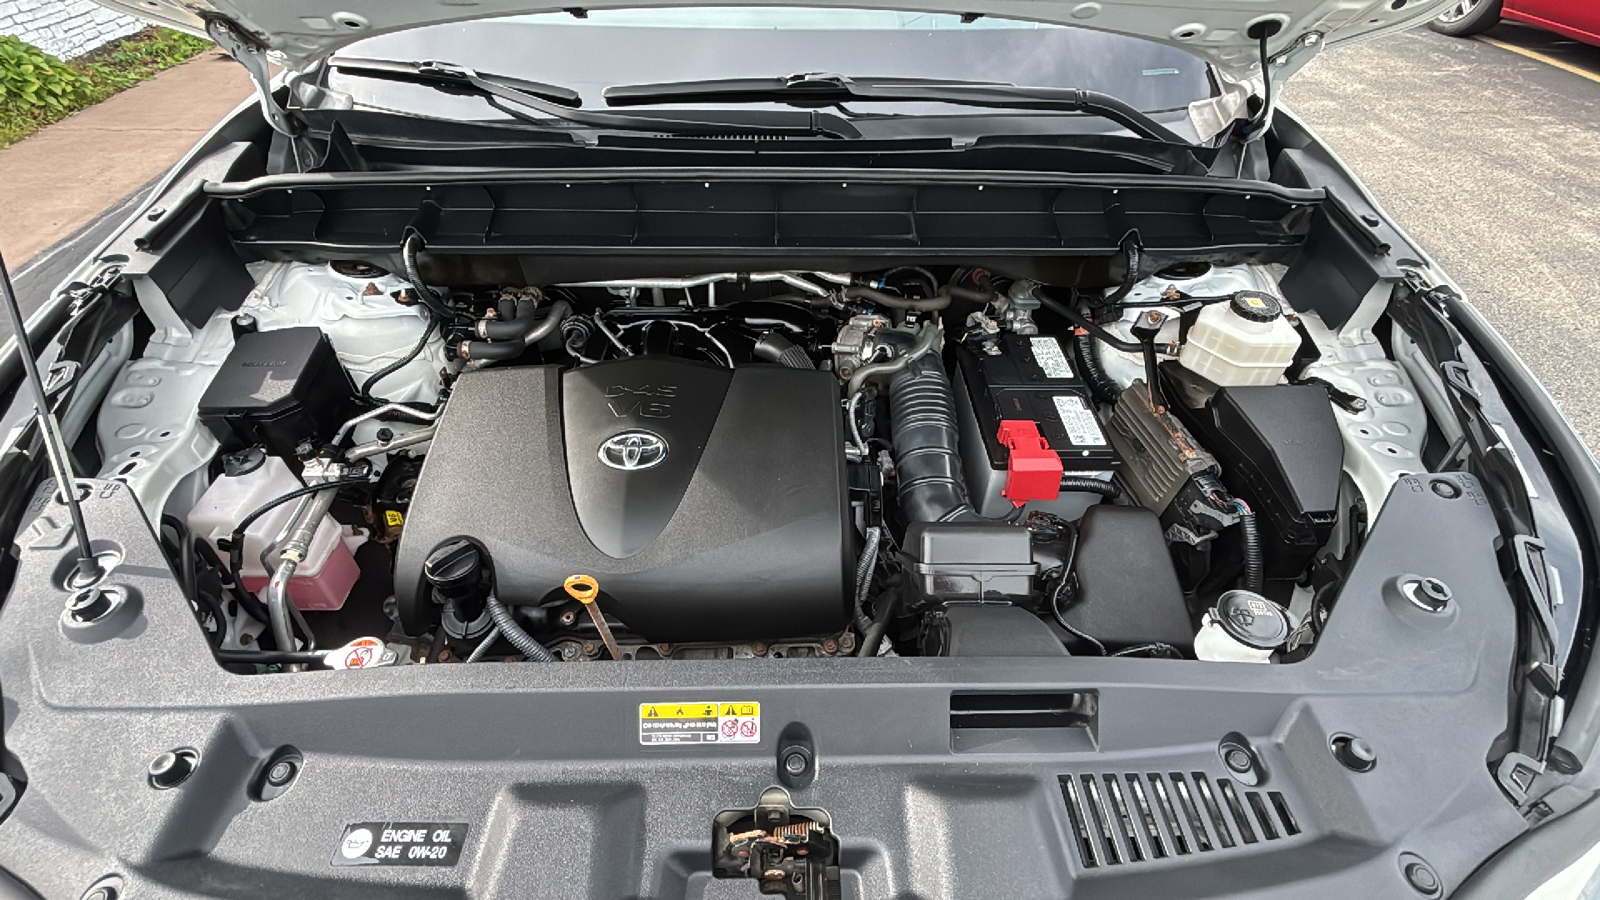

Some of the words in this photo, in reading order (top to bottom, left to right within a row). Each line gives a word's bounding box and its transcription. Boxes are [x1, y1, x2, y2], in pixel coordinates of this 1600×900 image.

[380, 829, 428, 843] ENGINE
[432, 829, 452, 843] OIL
[374, 845, 403, 859] SAE
